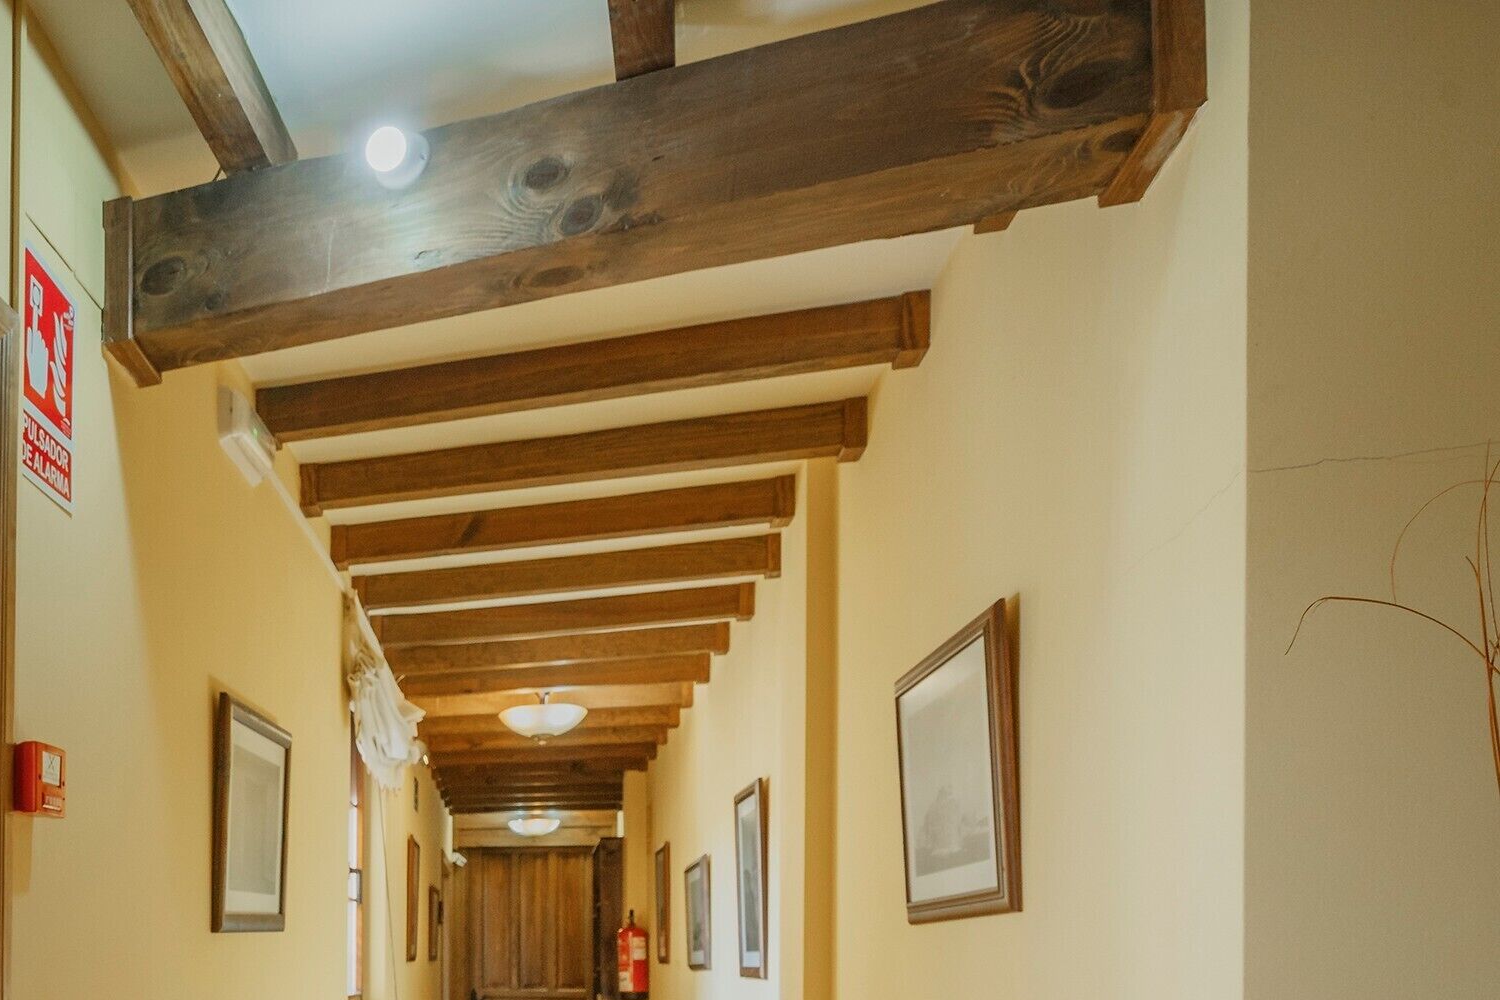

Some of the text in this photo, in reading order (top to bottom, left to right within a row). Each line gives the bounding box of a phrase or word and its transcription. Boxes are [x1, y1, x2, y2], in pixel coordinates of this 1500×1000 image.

[22, 440, 70, 498] DE ALARMA
[23, 413, 69, 472] PULSADOR
